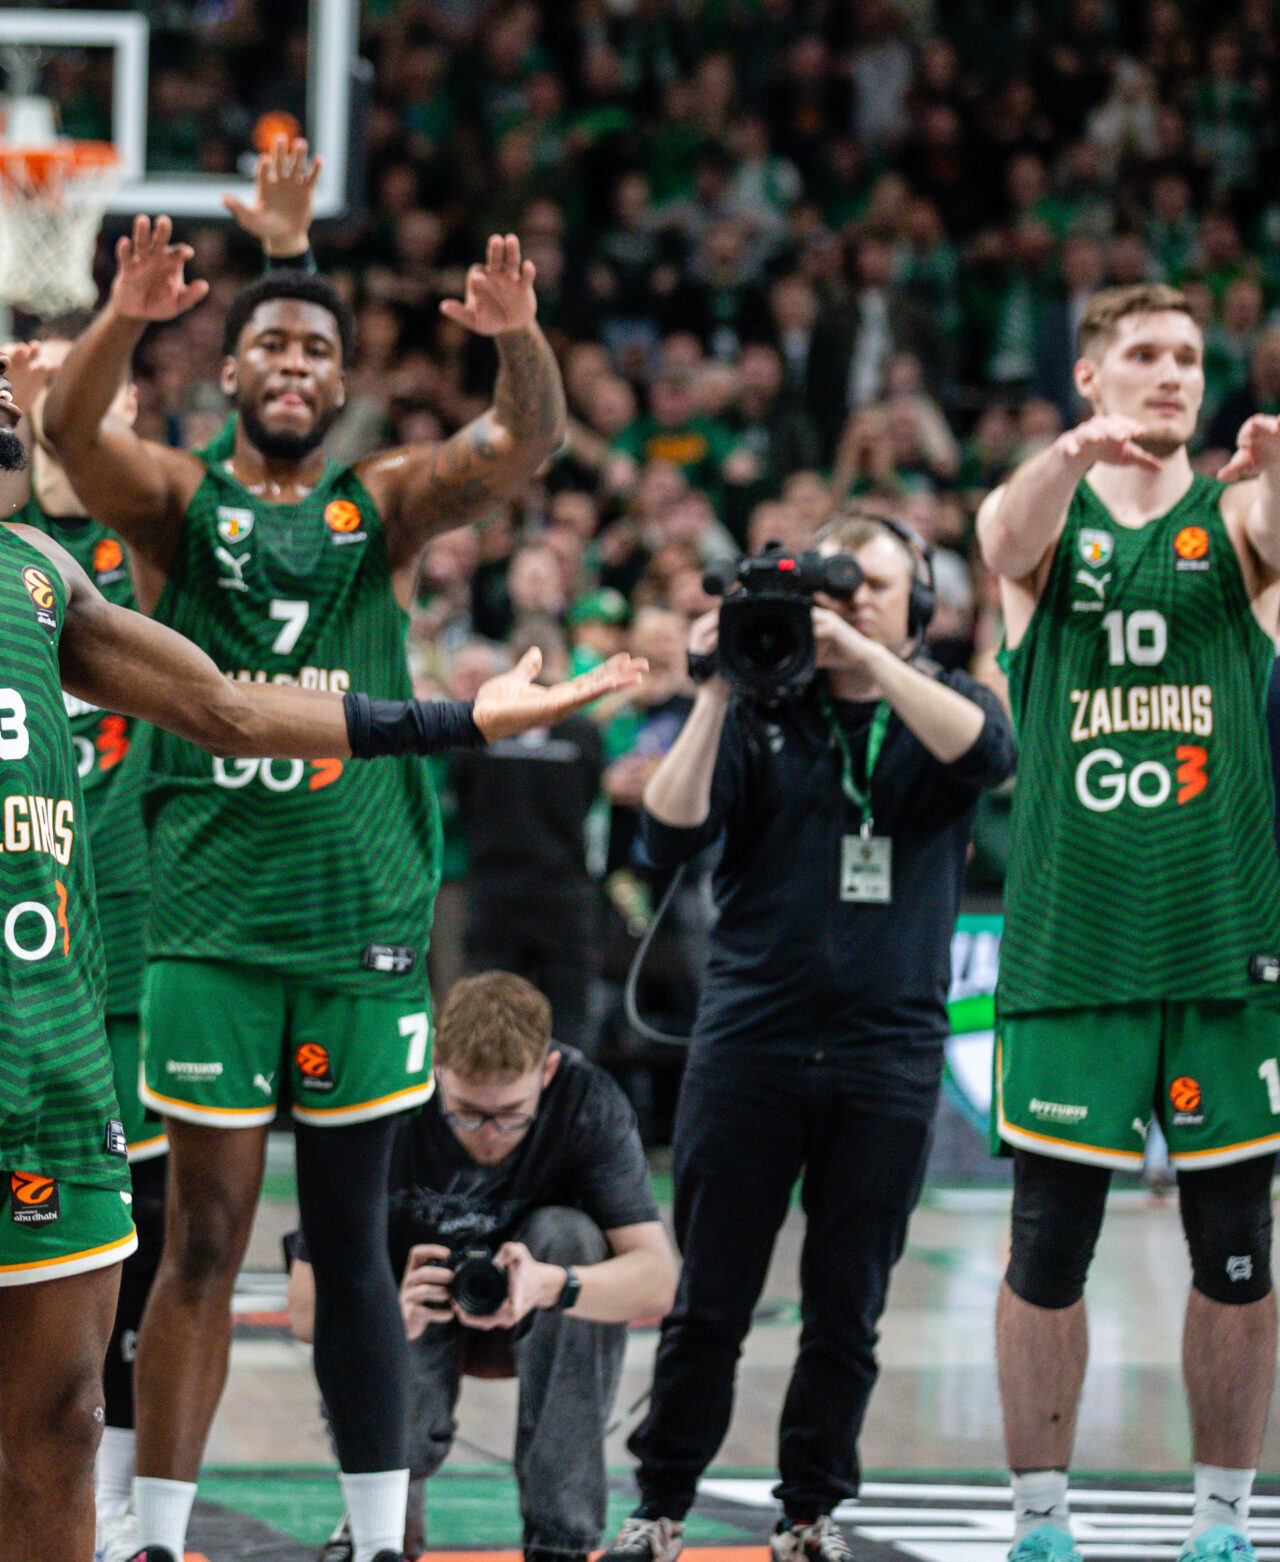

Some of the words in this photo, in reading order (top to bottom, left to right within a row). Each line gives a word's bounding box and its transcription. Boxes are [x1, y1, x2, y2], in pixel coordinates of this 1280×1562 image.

[270, 599, 309, 655] 7
[1101, 609, 1168, 667] 10
[1075, 745, 1209, 813] Go3
[398, 1011, 429, 1074] 7
[1258, 1058, 1280, 1115] 1
